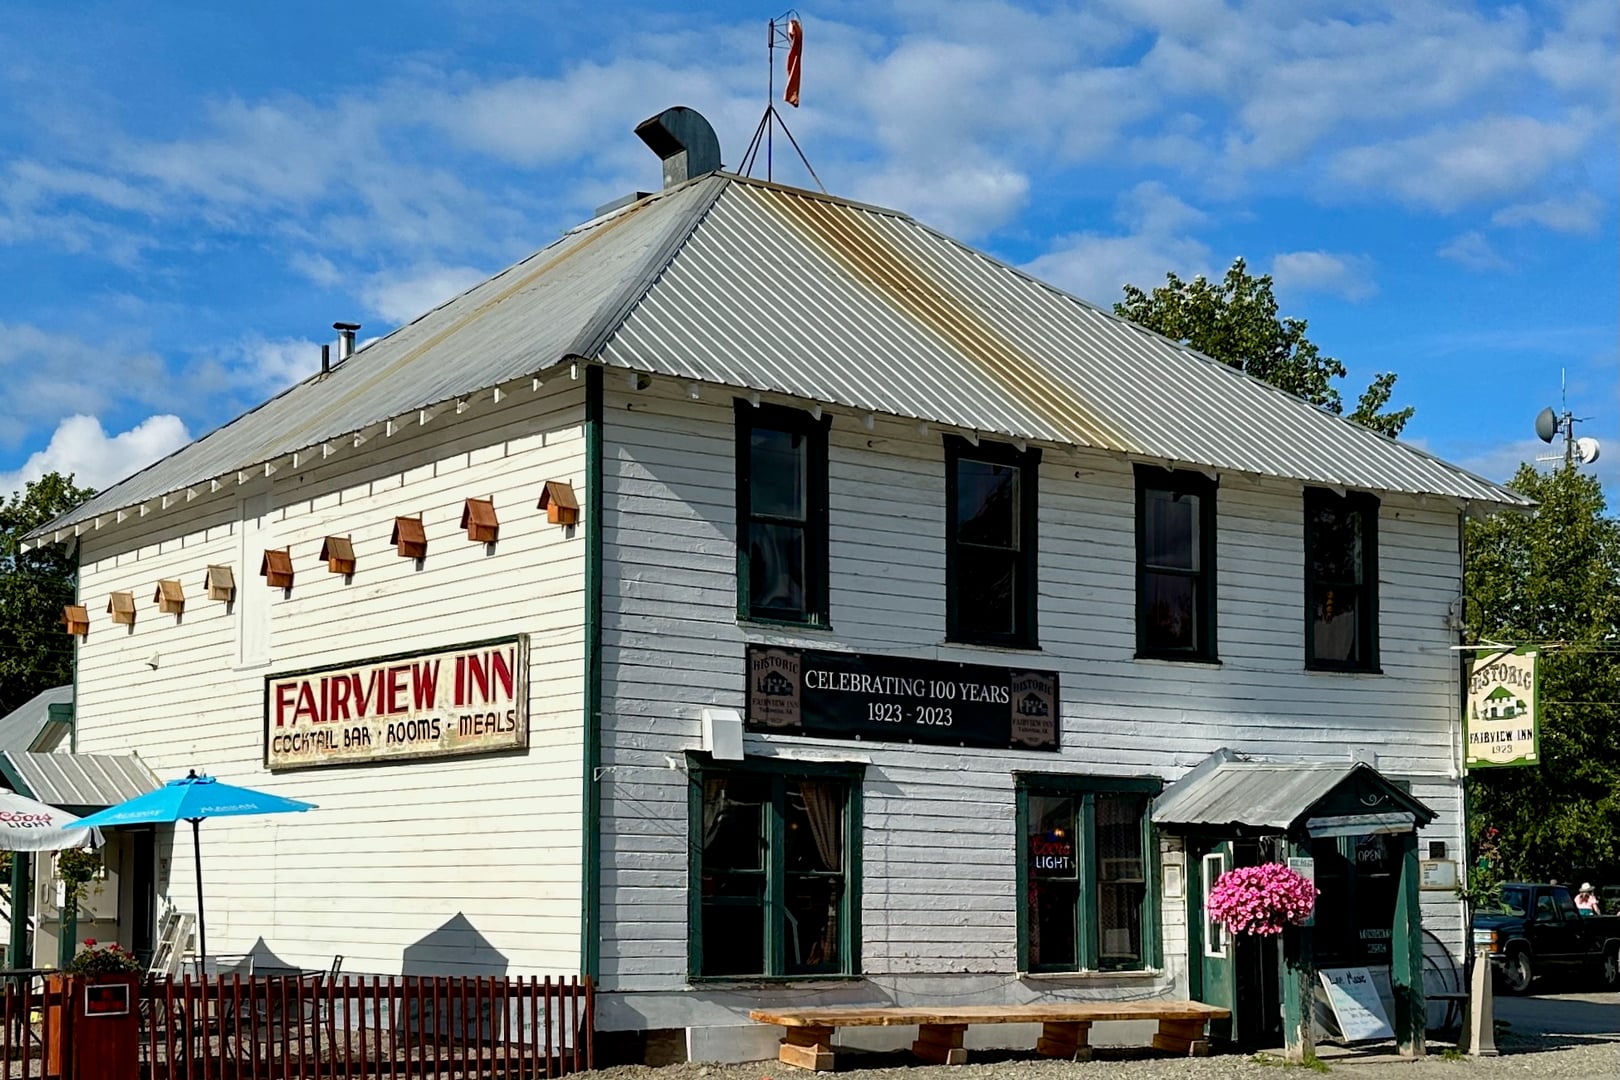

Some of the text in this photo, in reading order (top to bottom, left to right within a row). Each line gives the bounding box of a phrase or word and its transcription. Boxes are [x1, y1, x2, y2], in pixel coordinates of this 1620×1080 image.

[753, 656, 799, 674] HISTORIC
[805, 670, 1010, 703] CELEBRATING 100 YEARS
[1469, 663, 1531, 694] HISTORIC
[276, 647, 515, 727] FAIRVIEW INN
[1013, 680, 1052, 695] HISTORIC
[867, 702, 902, 723] 1923
[916, 706, 953, 726] 2023
[273, 710, 515, 753] COCKTAIL BAR ROOMS MEALS
[1470, 729, 1533, 744] FAIRVIEW INN
[1492, 745, 1513, 754] 1923
[0, 811, 53, 822] Coors
[1035, 856, 1070, 869] LIGHT
[1358, 849, 1382, 861] OPEN
